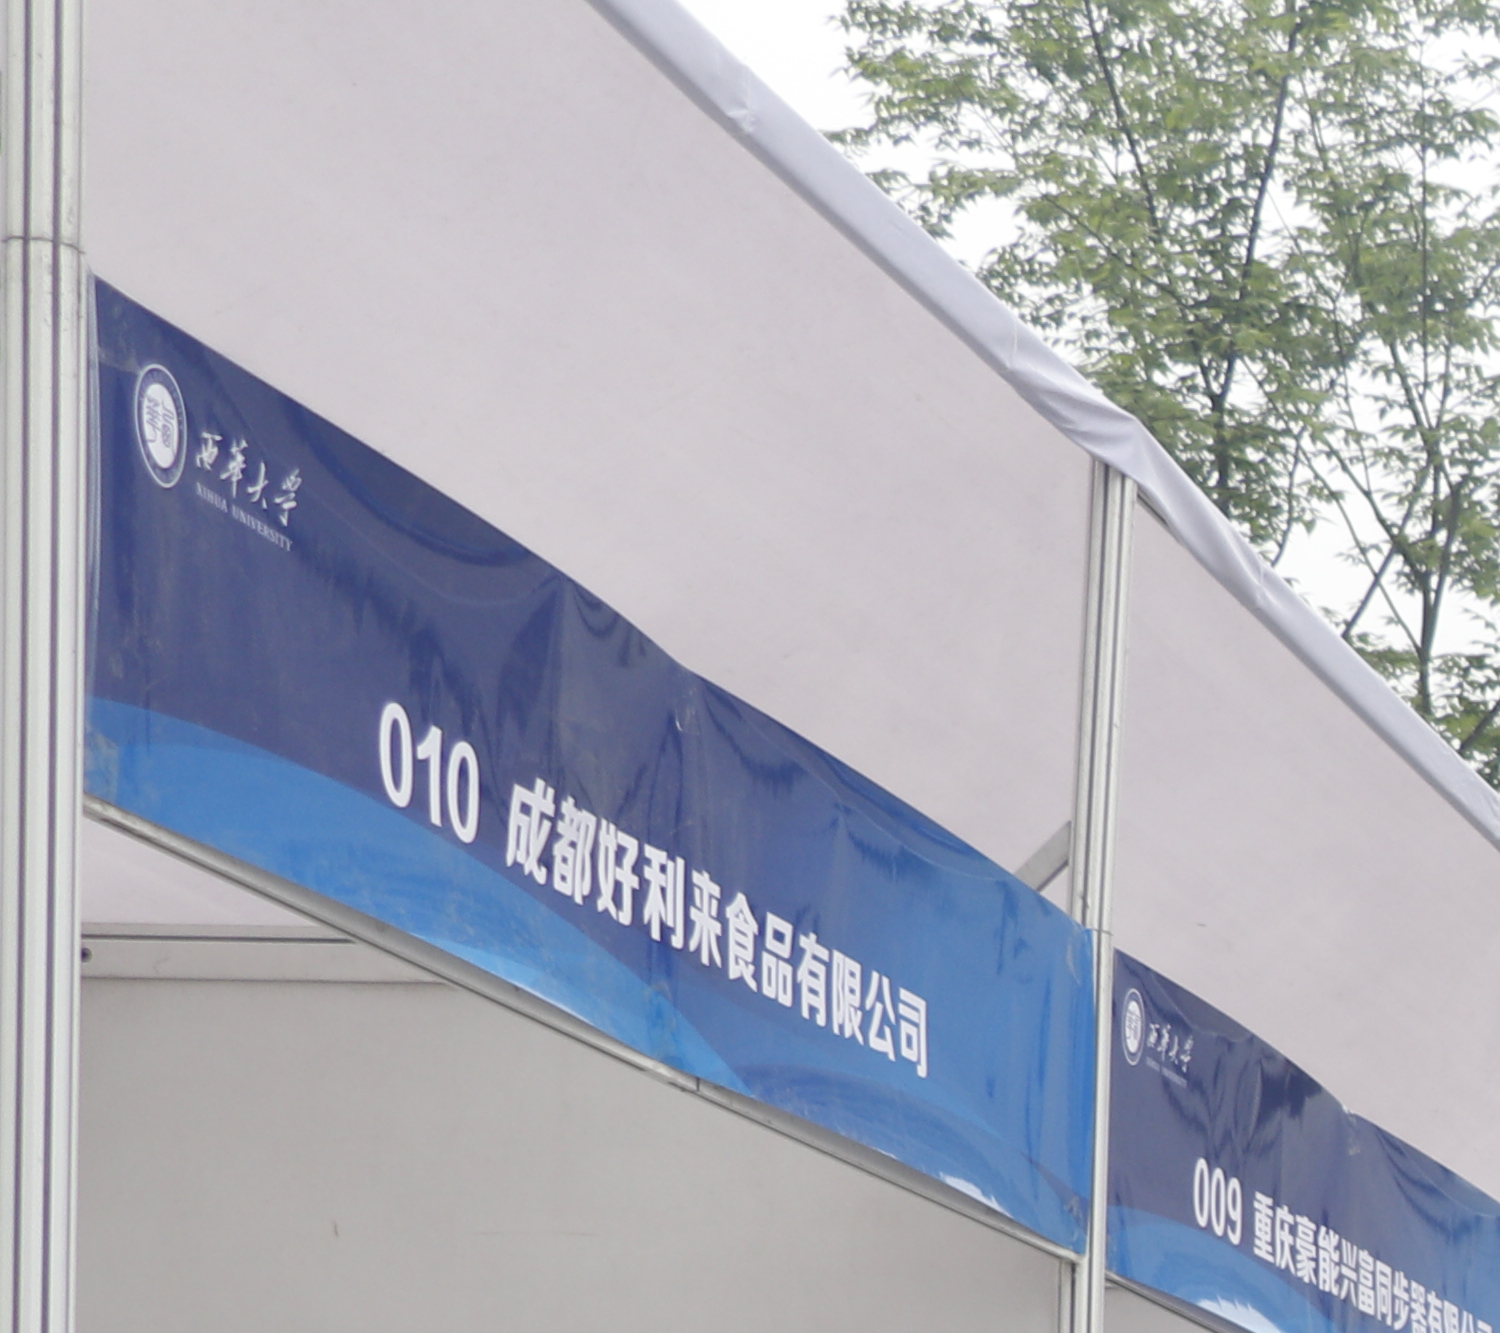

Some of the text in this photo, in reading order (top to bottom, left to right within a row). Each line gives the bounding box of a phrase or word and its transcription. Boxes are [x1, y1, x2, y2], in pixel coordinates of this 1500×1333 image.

[231, 504, 293, 552] UNIVERSITY
[378, 701, 929, 1079] 010 成都好利来食品有限公司
[1193, 1157, 1243, 1246] 009
